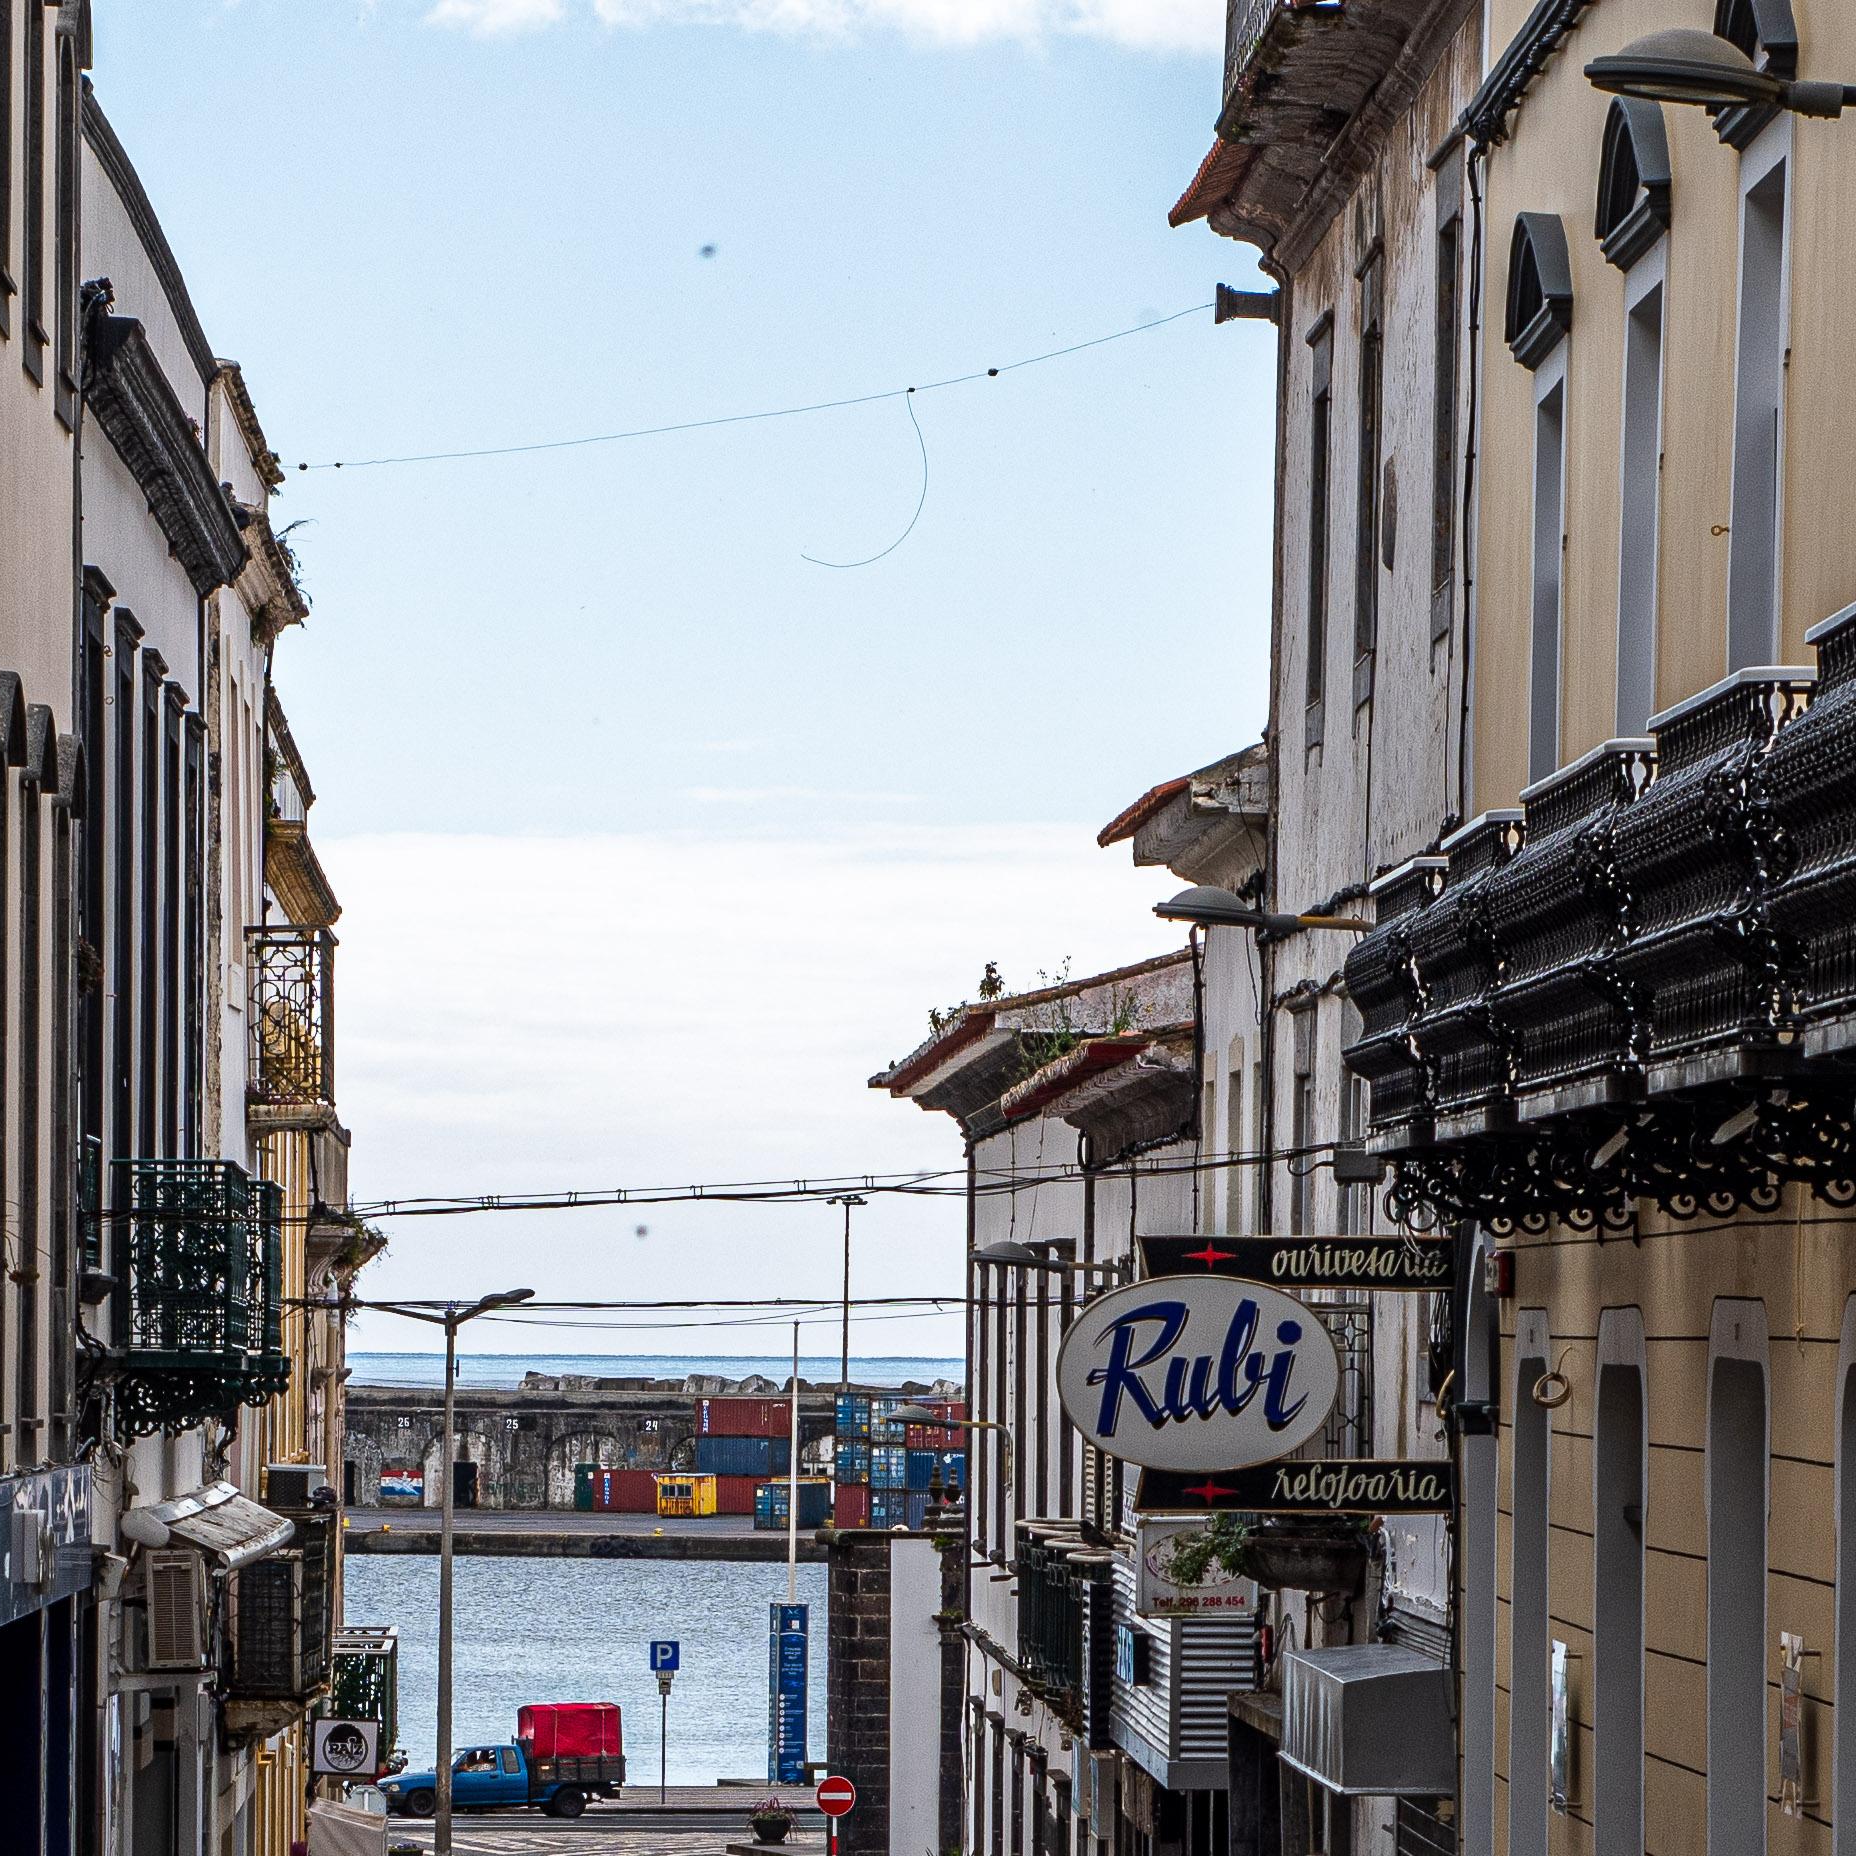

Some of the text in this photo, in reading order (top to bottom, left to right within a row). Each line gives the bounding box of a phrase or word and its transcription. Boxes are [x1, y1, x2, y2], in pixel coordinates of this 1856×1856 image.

[1271, 1240, 1446, 1283] ourivesaria
[1086, 1298, 1309, 1437] Rubi
[397, 1416, 410, 1428] 26
[506, 1418, 519, 1430] 25
[645, 1420, 658, 1431] 24
[1271, 1463, 1446, 1508] relojoaria
[656, 1644, 673, 1668] P
